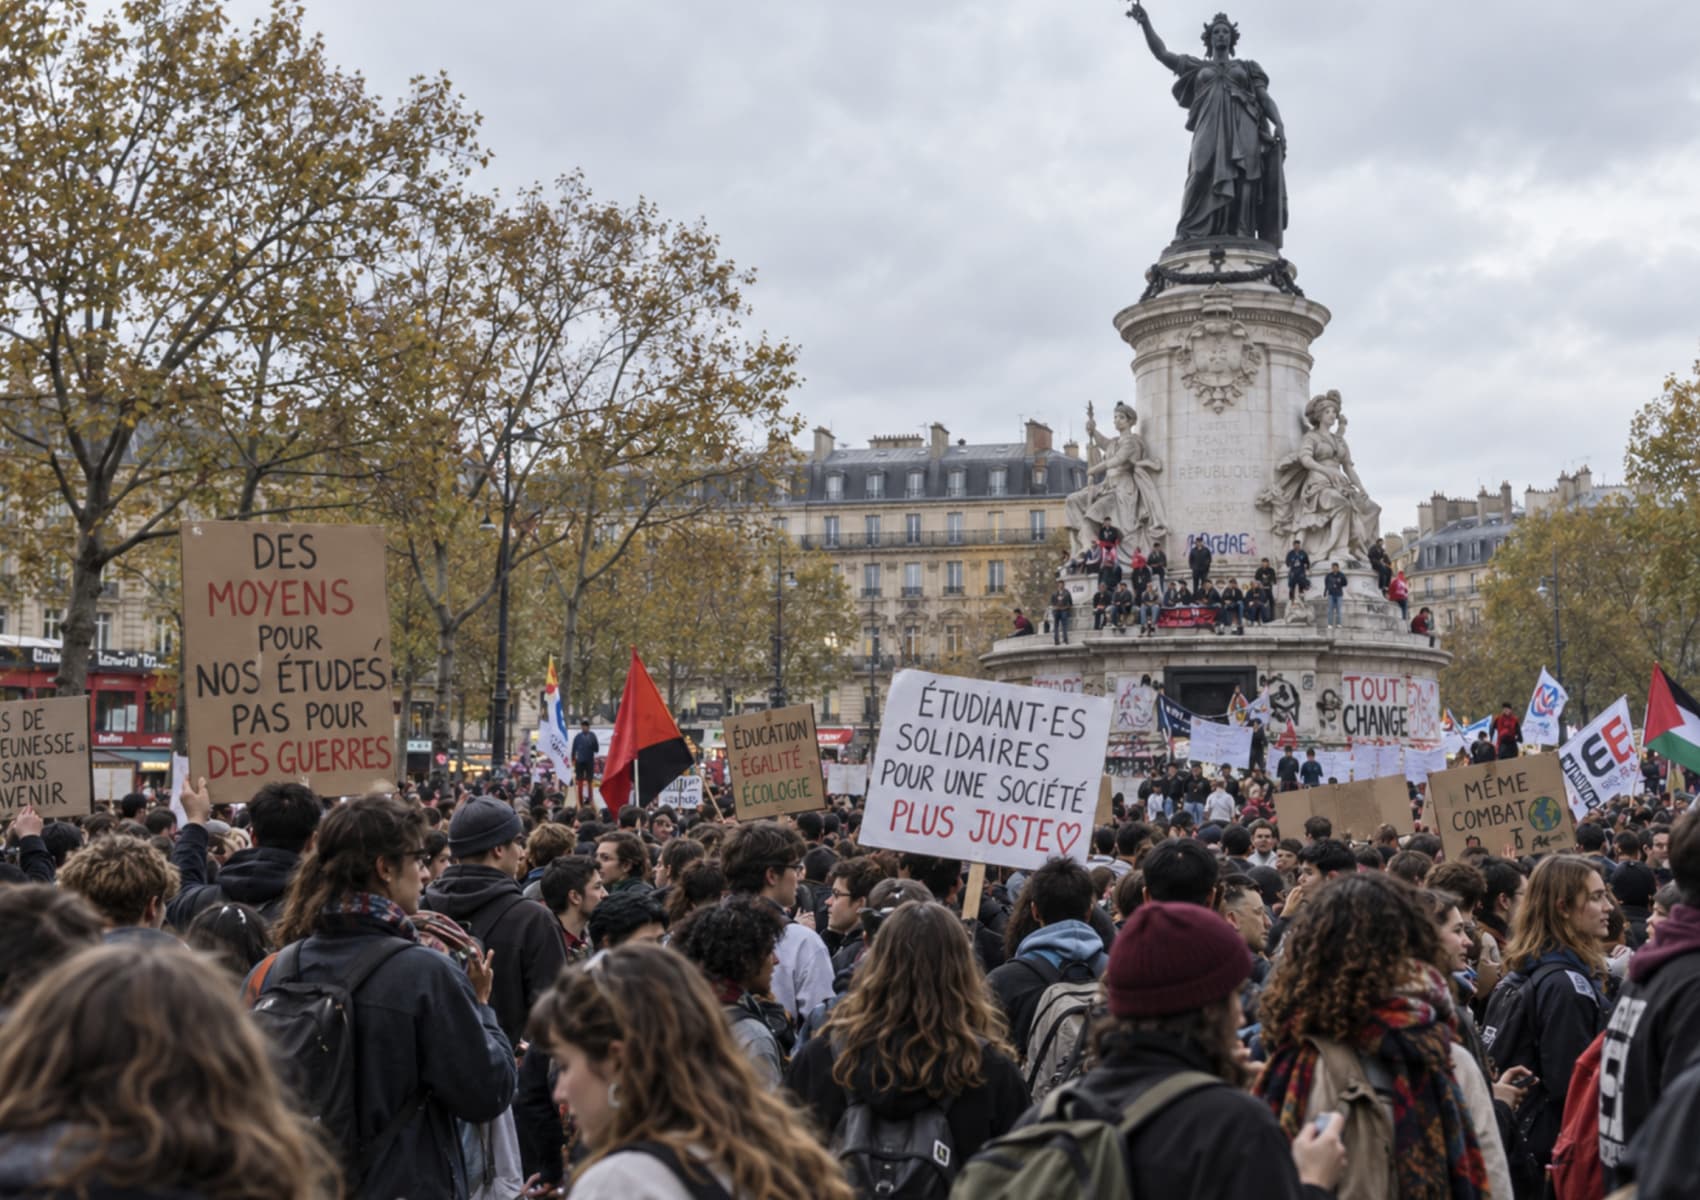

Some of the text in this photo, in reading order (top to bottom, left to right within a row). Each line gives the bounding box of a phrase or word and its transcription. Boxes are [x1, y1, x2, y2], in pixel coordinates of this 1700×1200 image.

[253, 533, 317, 570] DES
[208, 578, 354, 617] MOYENS
[258, 624, 322, 652] POUR
[196, 659, 261, 698] NOS
[1343, 676, 1400, 703] TOUT
[0, 708, 45, 733] S DE
[232, 701, 368, 735] PAS POUR
[732, 720, 808, 750] ÉDUCATION
[1343, 704, 1408, 737] CHANGE
[2, 759, 47, 783] SANS
[207, 735, 392, 779] DES GUERRES
[741, 744, 802, 778] ÉGALITÉ
[880, 759, 935, 792] POUR
[944, 768, 988, 798] UNE
[889, 799, 1054, 852] PLUS JUSTE
[1452, 800, 1526, 832] COMBAT
